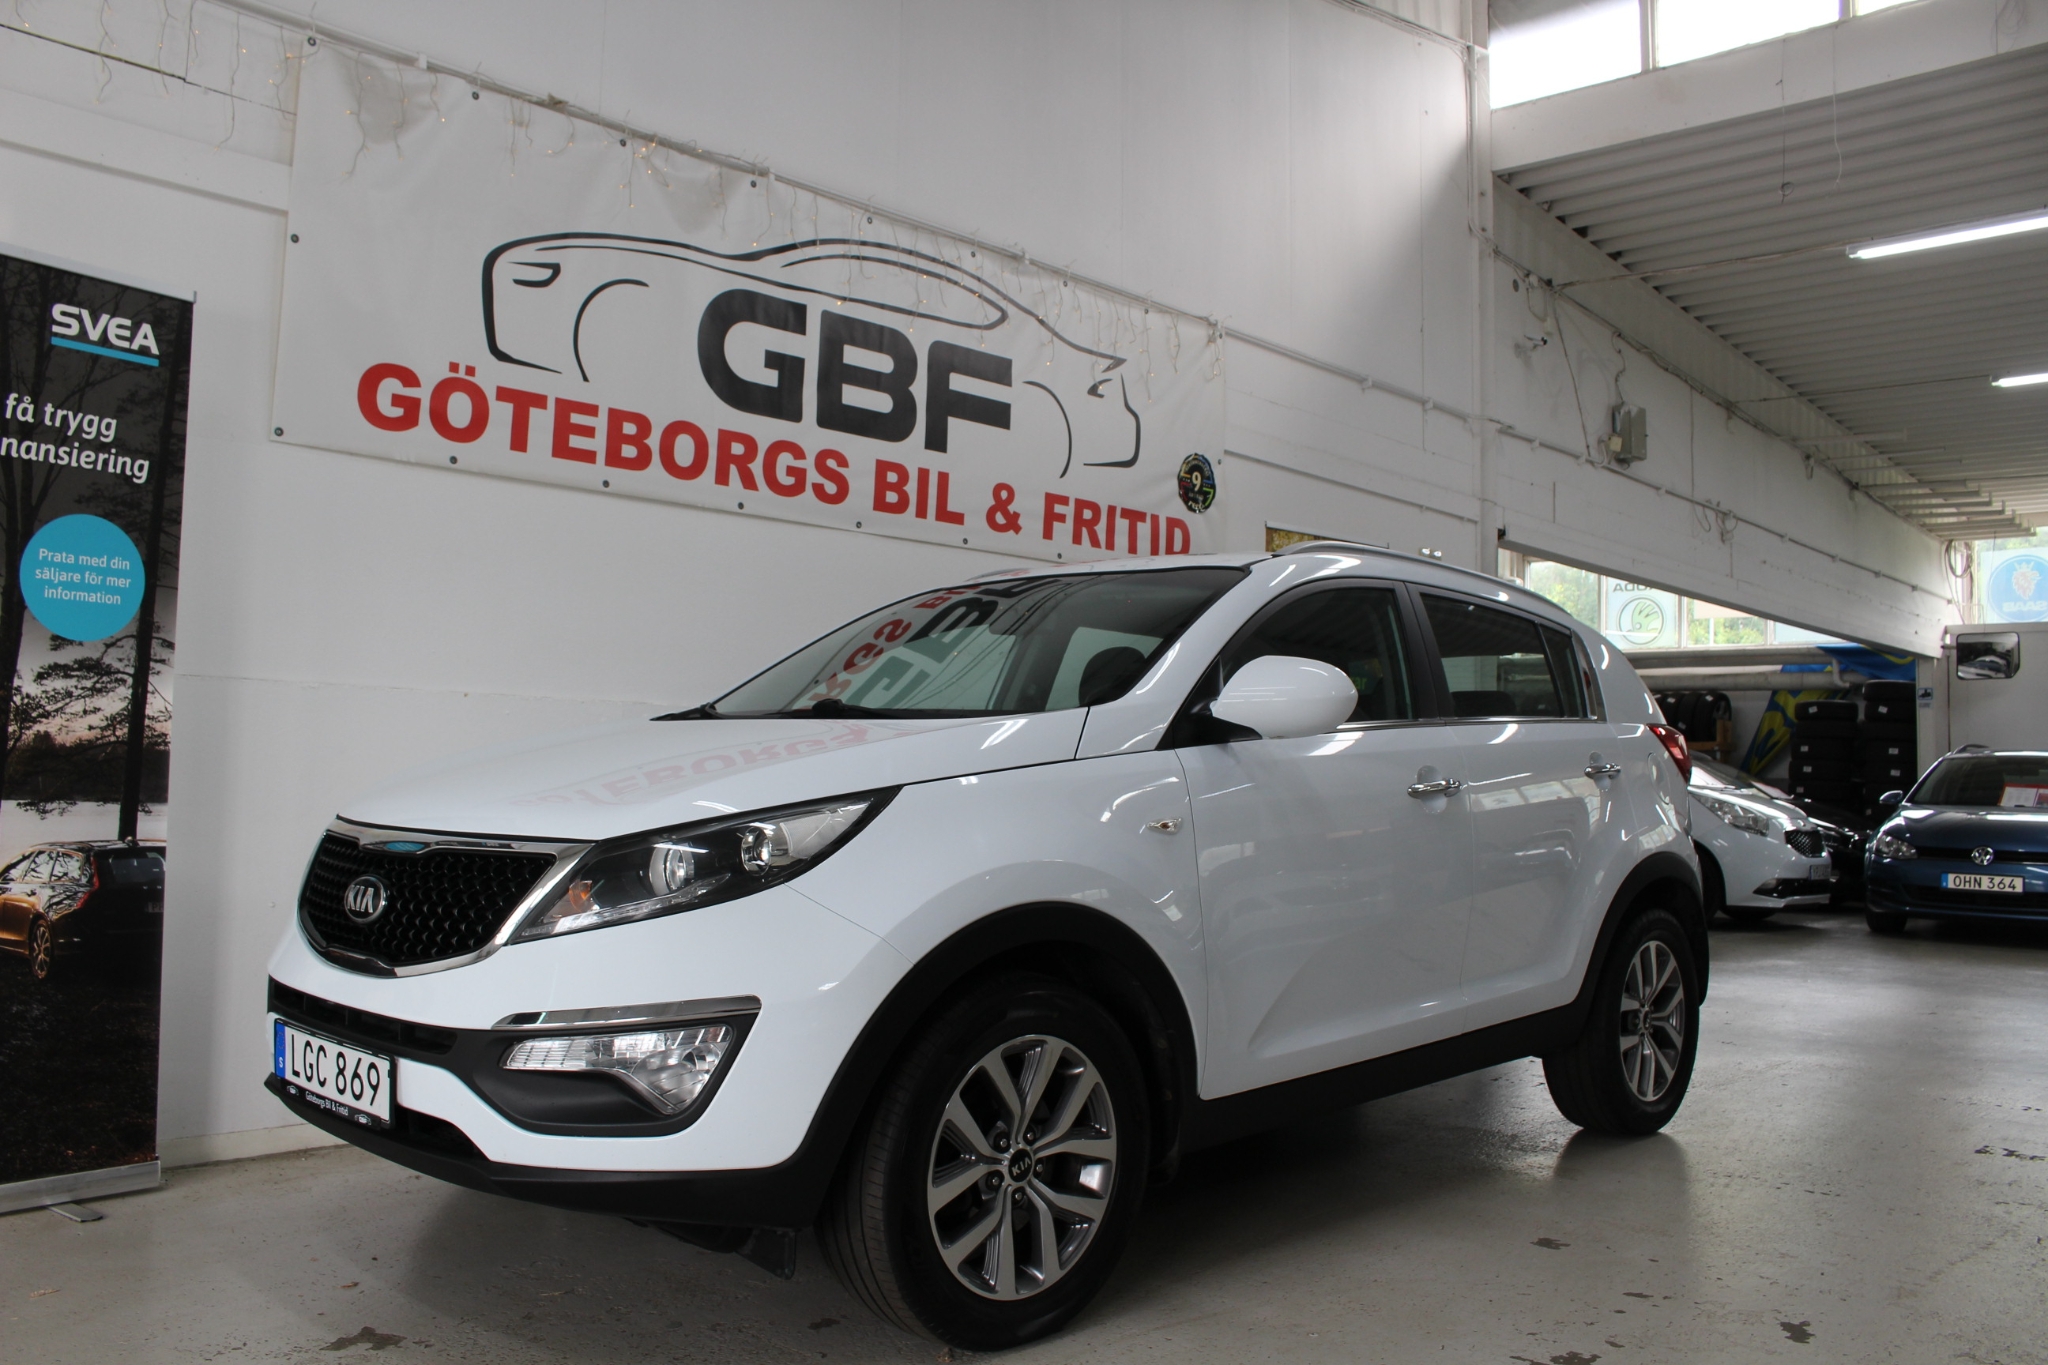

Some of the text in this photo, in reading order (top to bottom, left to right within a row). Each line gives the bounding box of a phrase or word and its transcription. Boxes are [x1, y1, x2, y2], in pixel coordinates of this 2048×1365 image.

[52, 303, 160, 356] SVEA
[697, 288, 1013, 454] GBF
[5, 393, 117, 443] få trygg
[357, 361, 1191, 556] GÖTEBORGS BIL & FRITID
[39, 548, 130, 570] Prata med din
[35, 567, 131, 588] säljare för mer
[44, 585, 121, 605] information
[1952, 875, 2017, 891] OHN 364
[347, 884, 375, 914] KIA
[291, 1033, 380, 1107] LGC 869
[1011, 1156, 1031, 1177] KIA
